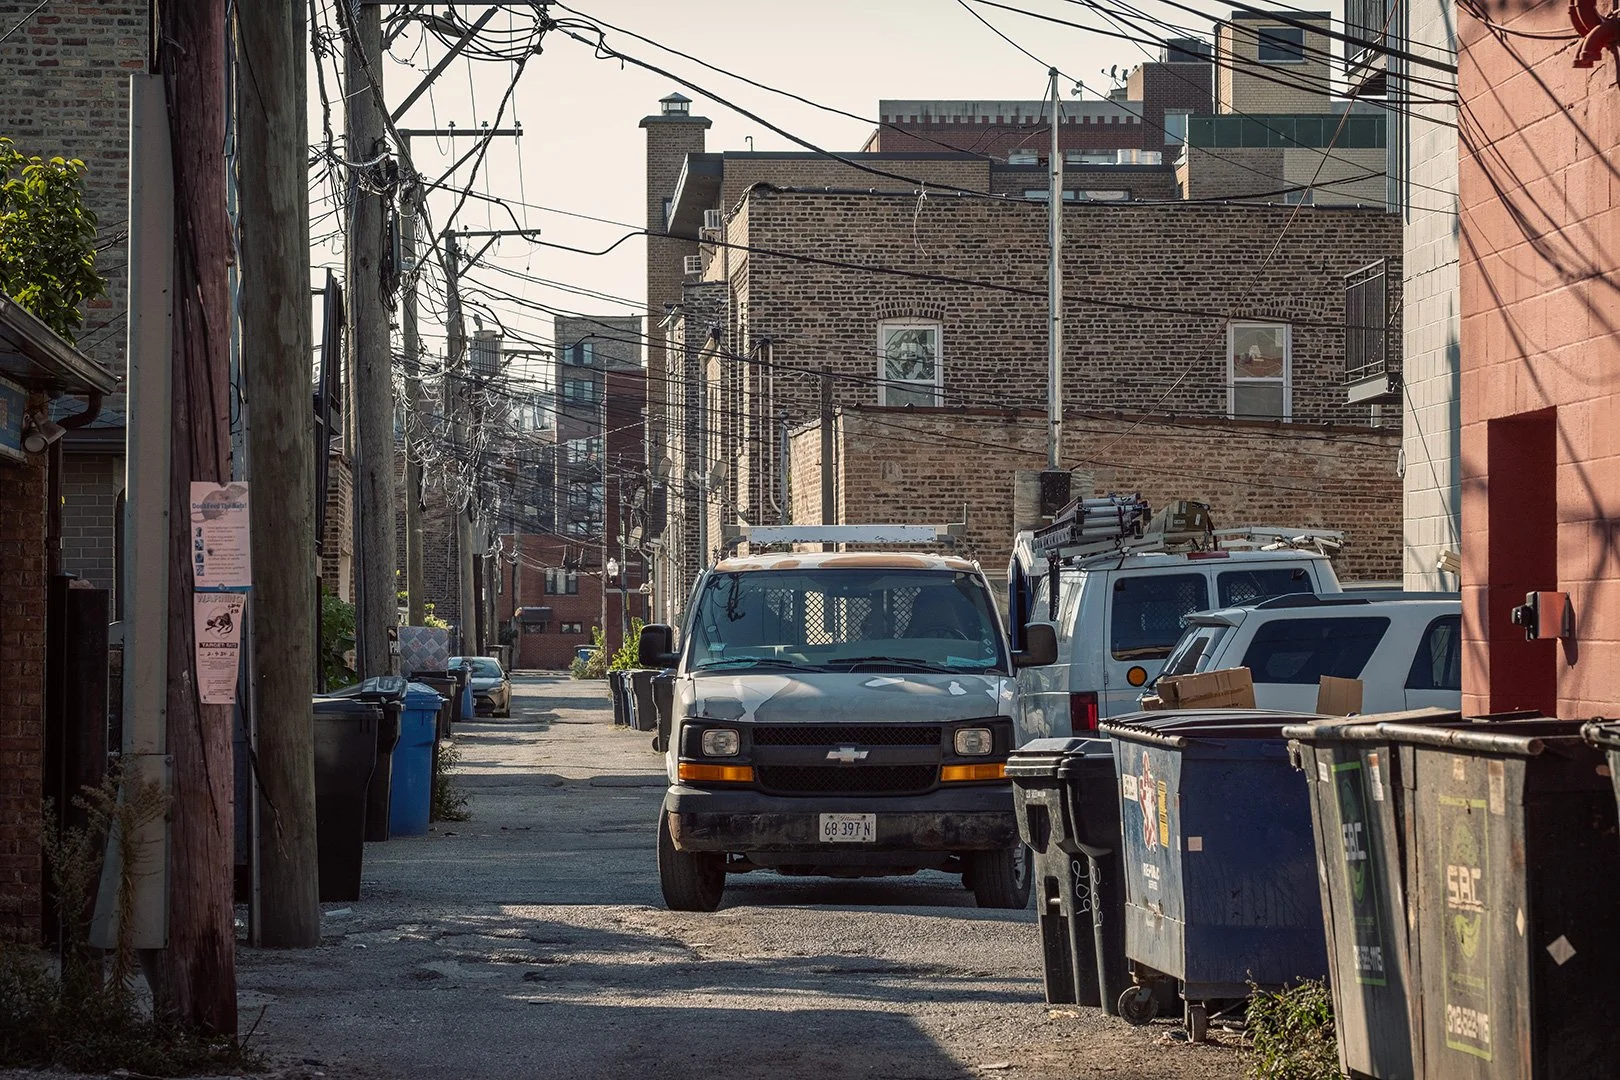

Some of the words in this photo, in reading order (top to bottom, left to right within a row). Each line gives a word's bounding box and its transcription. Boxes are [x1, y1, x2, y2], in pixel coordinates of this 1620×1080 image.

[196, 594, 244, 604] WARNING
[824, 822, 838, 836] 68
[841, 822, 860, 836] 397
[864, 822, 871, 836] N
[1342, 822, 1368, 861] SBC
[1447, 865, 1485, 913] SBC
